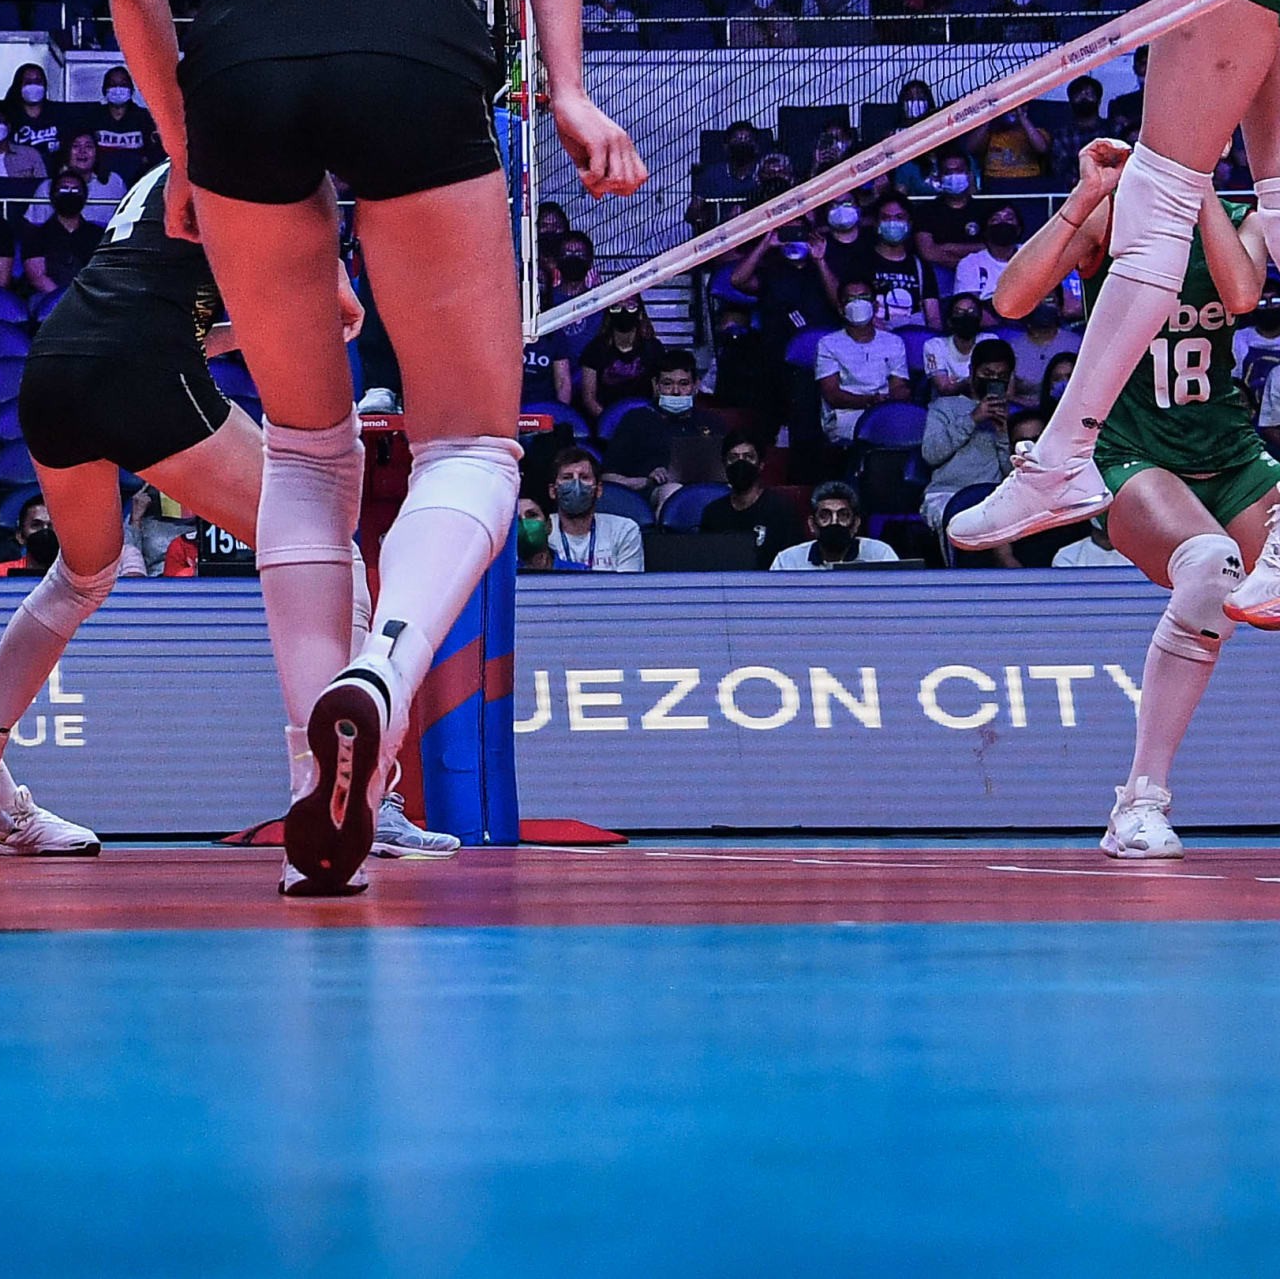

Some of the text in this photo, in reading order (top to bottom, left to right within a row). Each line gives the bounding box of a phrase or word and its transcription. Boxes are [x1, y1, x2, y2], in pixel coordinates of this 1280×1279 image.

[105, 156, 172, 243] 4
[1150, 337, 1213, 409] 18
[518, 419, 540, 428] enoh
[513, 664, 883, 733] UEZON
